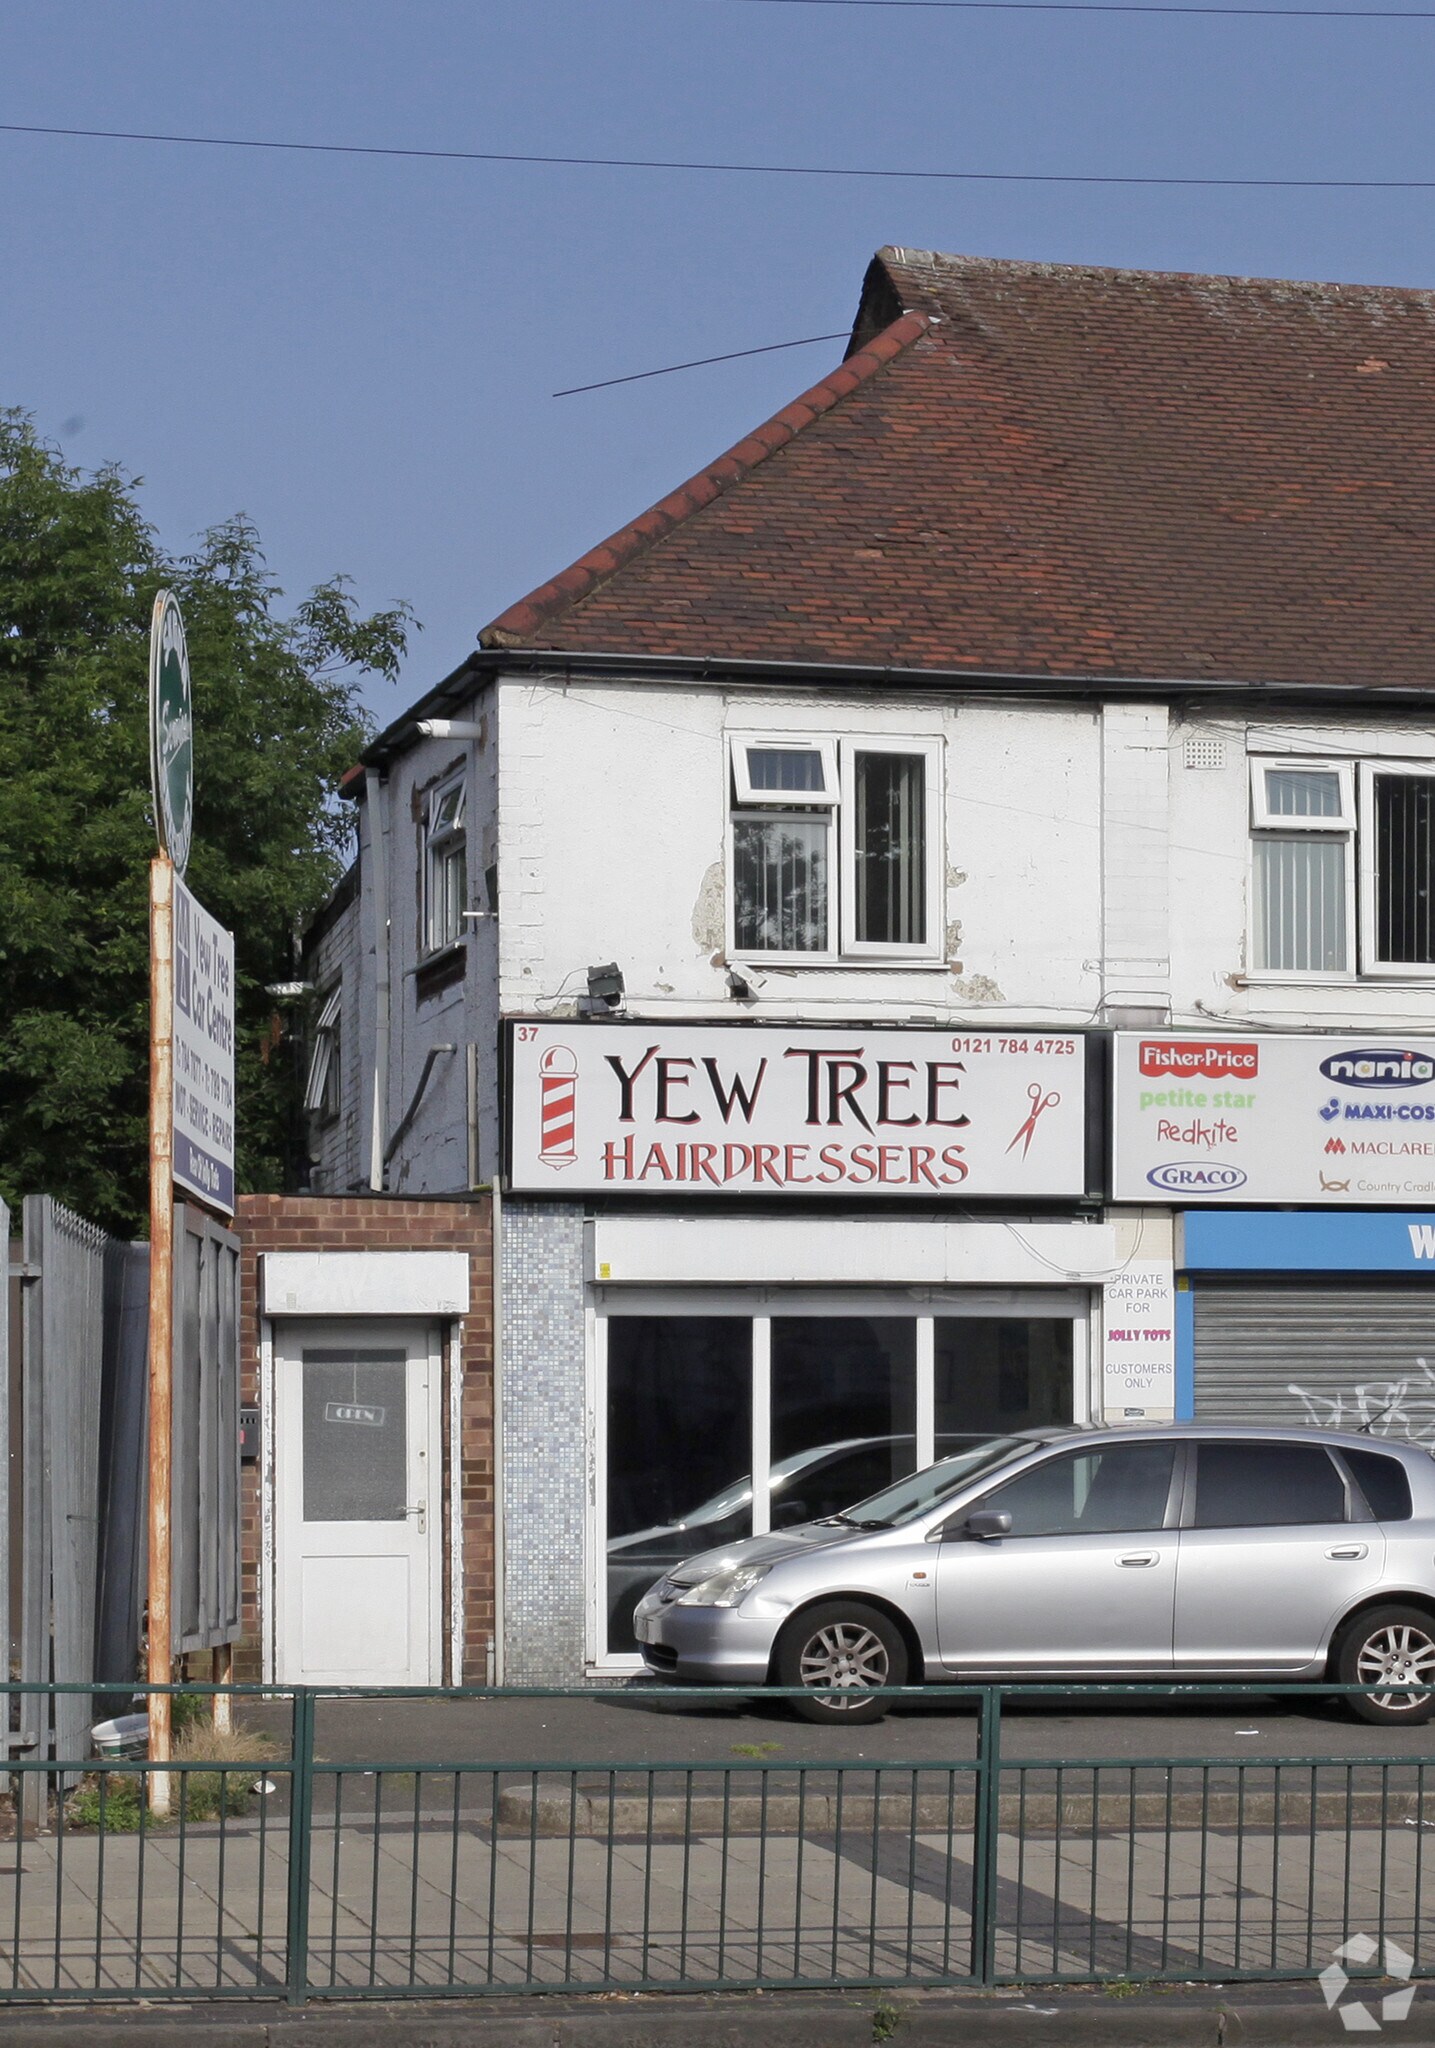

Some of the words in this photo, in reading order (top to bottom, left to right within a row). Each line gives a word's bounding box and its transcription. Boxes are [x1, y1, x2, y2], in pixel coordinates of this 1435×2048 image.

[194, 912, 211, 979] Yew
[212, 931, 229, 998] Tree
[192, 969, 205, 1033] Car
[206, 984, 232, 1056] Centre
[517, 1027, 540, 1043] 37
[951, 1037, 991, 1053] 0121
[998, 1038, 1029, 1053] 784
[1034, 1039, 1075, 1055] 4725
[1143, 1046, 1256, 1068] Fisher-Price
[1329, 1051, 1434, 1079] nania
[603, 1044, 768, 1125] YEW
[782, 1046, 971, 1137] TREE
[1139, 1088, 1208, 1111] petite
[1212, 1090, 1257, 1109] star
[1351, 1141, 1435, 1156] MACLARE
[600, 1133, 970, 1189] HAIRDRESSERS
[1161, 1167, 1238, 1185] GRACO
[1357, 1179, 1401, 1194] Country
[1403, 1180, 1435, 1192] Cradl
[1115, 1274, 1163, 1284] PRIVATE
[1108, 1288, 1133, 1299] CAR
[1136, 1288, 1168, 1299] PARK
[1126, 1302, 1151, 1313] FOR
[1107, 1329, 1141, 1341] JOLLY
[1143, 1329, 1171, 1341] TOTS
[1105, 1363, 1172, 1375] CUSTOMERS
[1124, 1377, 1153, 1389] ONLY
